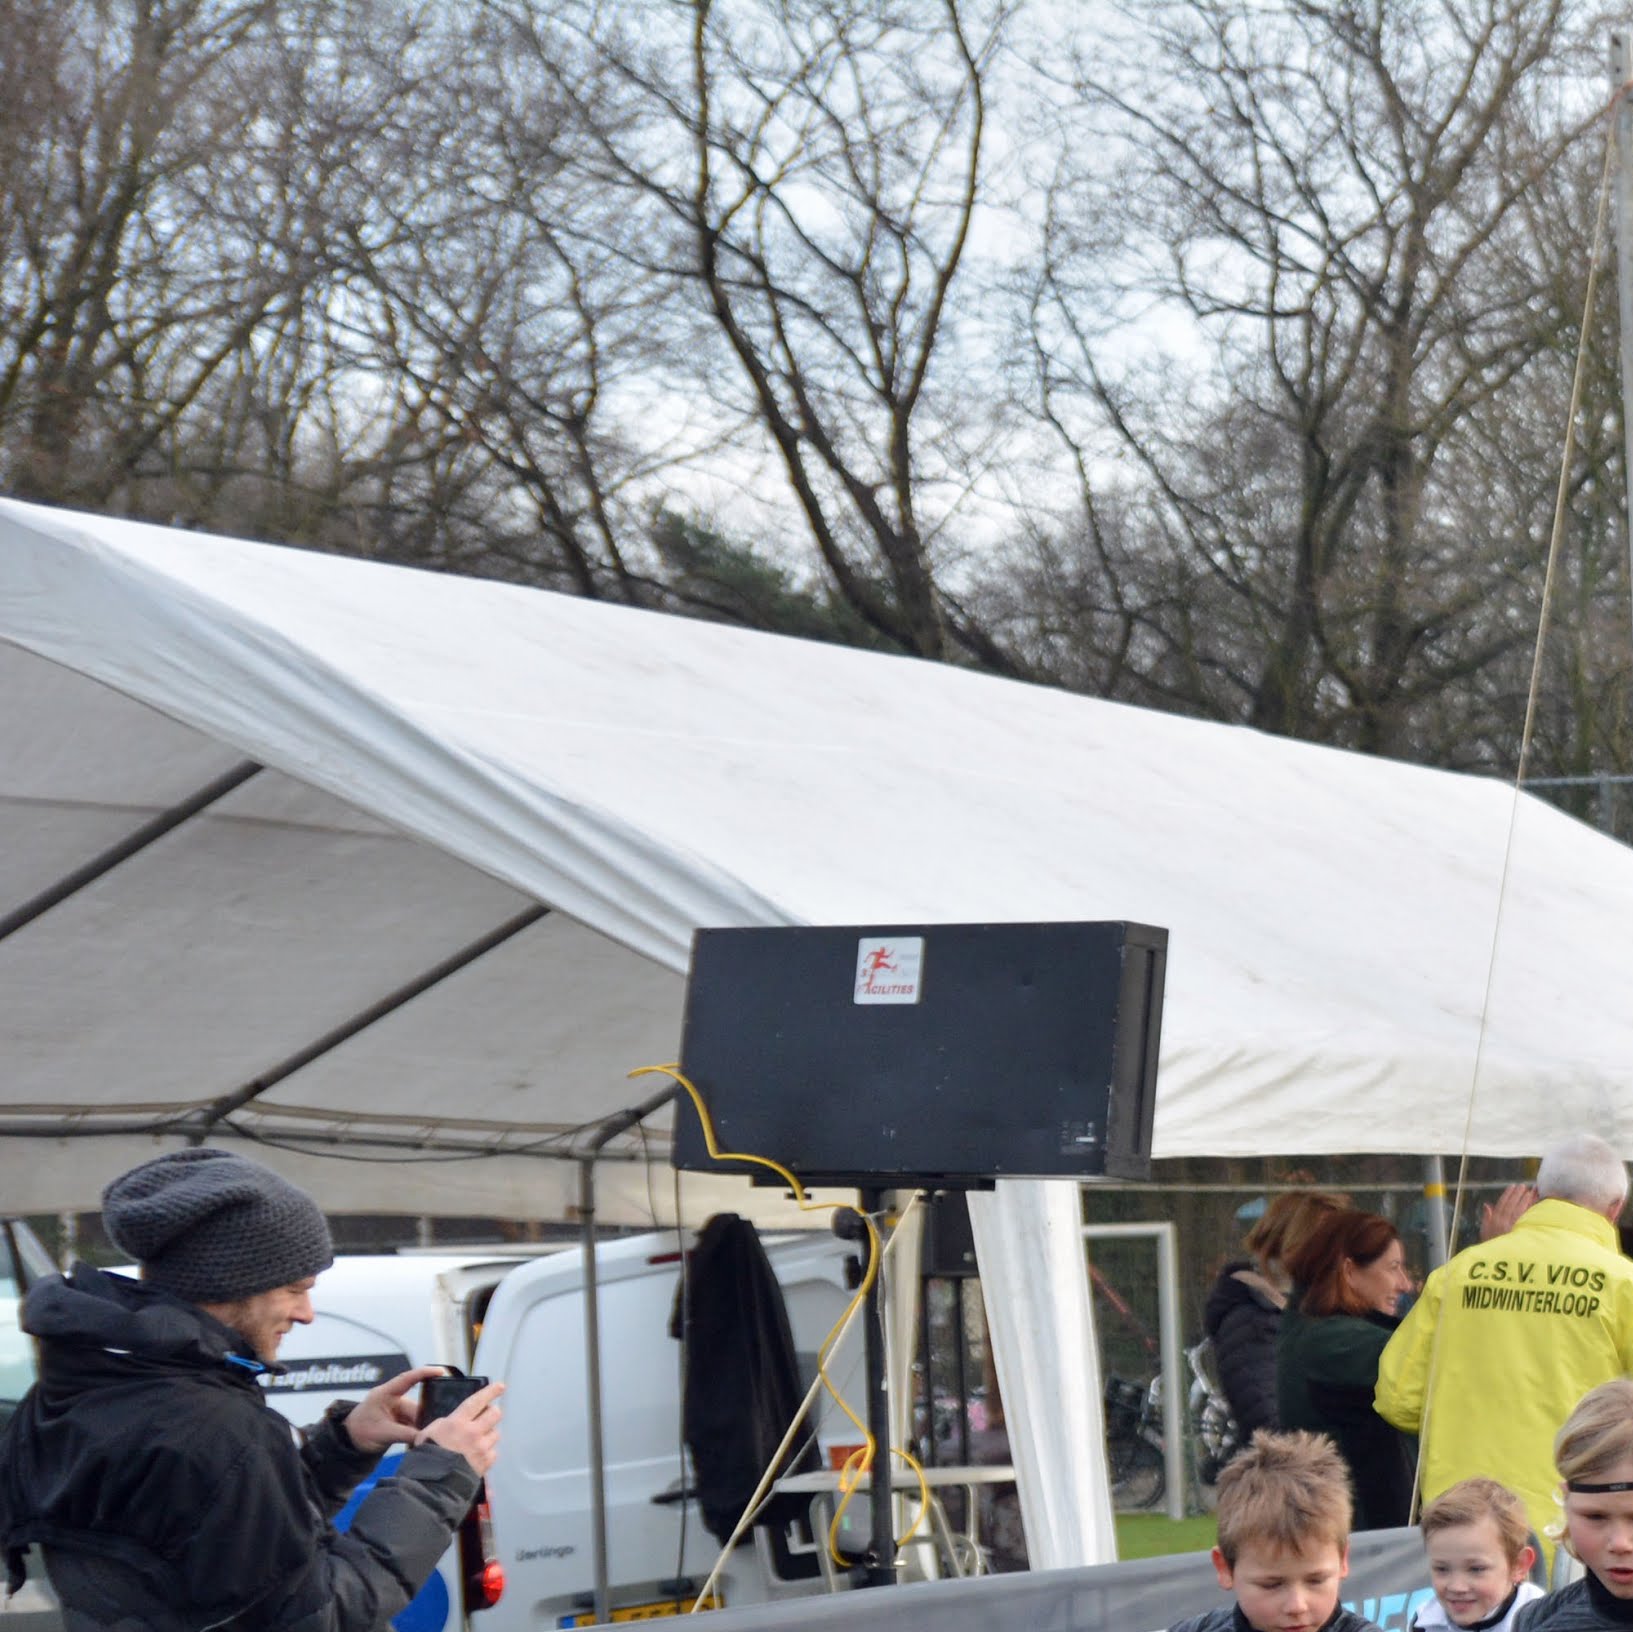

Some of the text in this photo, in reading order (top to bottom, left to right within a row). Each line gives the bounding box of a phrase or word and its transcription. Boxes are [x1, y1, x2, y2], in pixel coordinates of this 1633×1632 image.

[1468, 1261, 1606, 1292] C.S.V. VIOS
[1462, 1284, 1600, 1318] MIDWINTERLOOP
